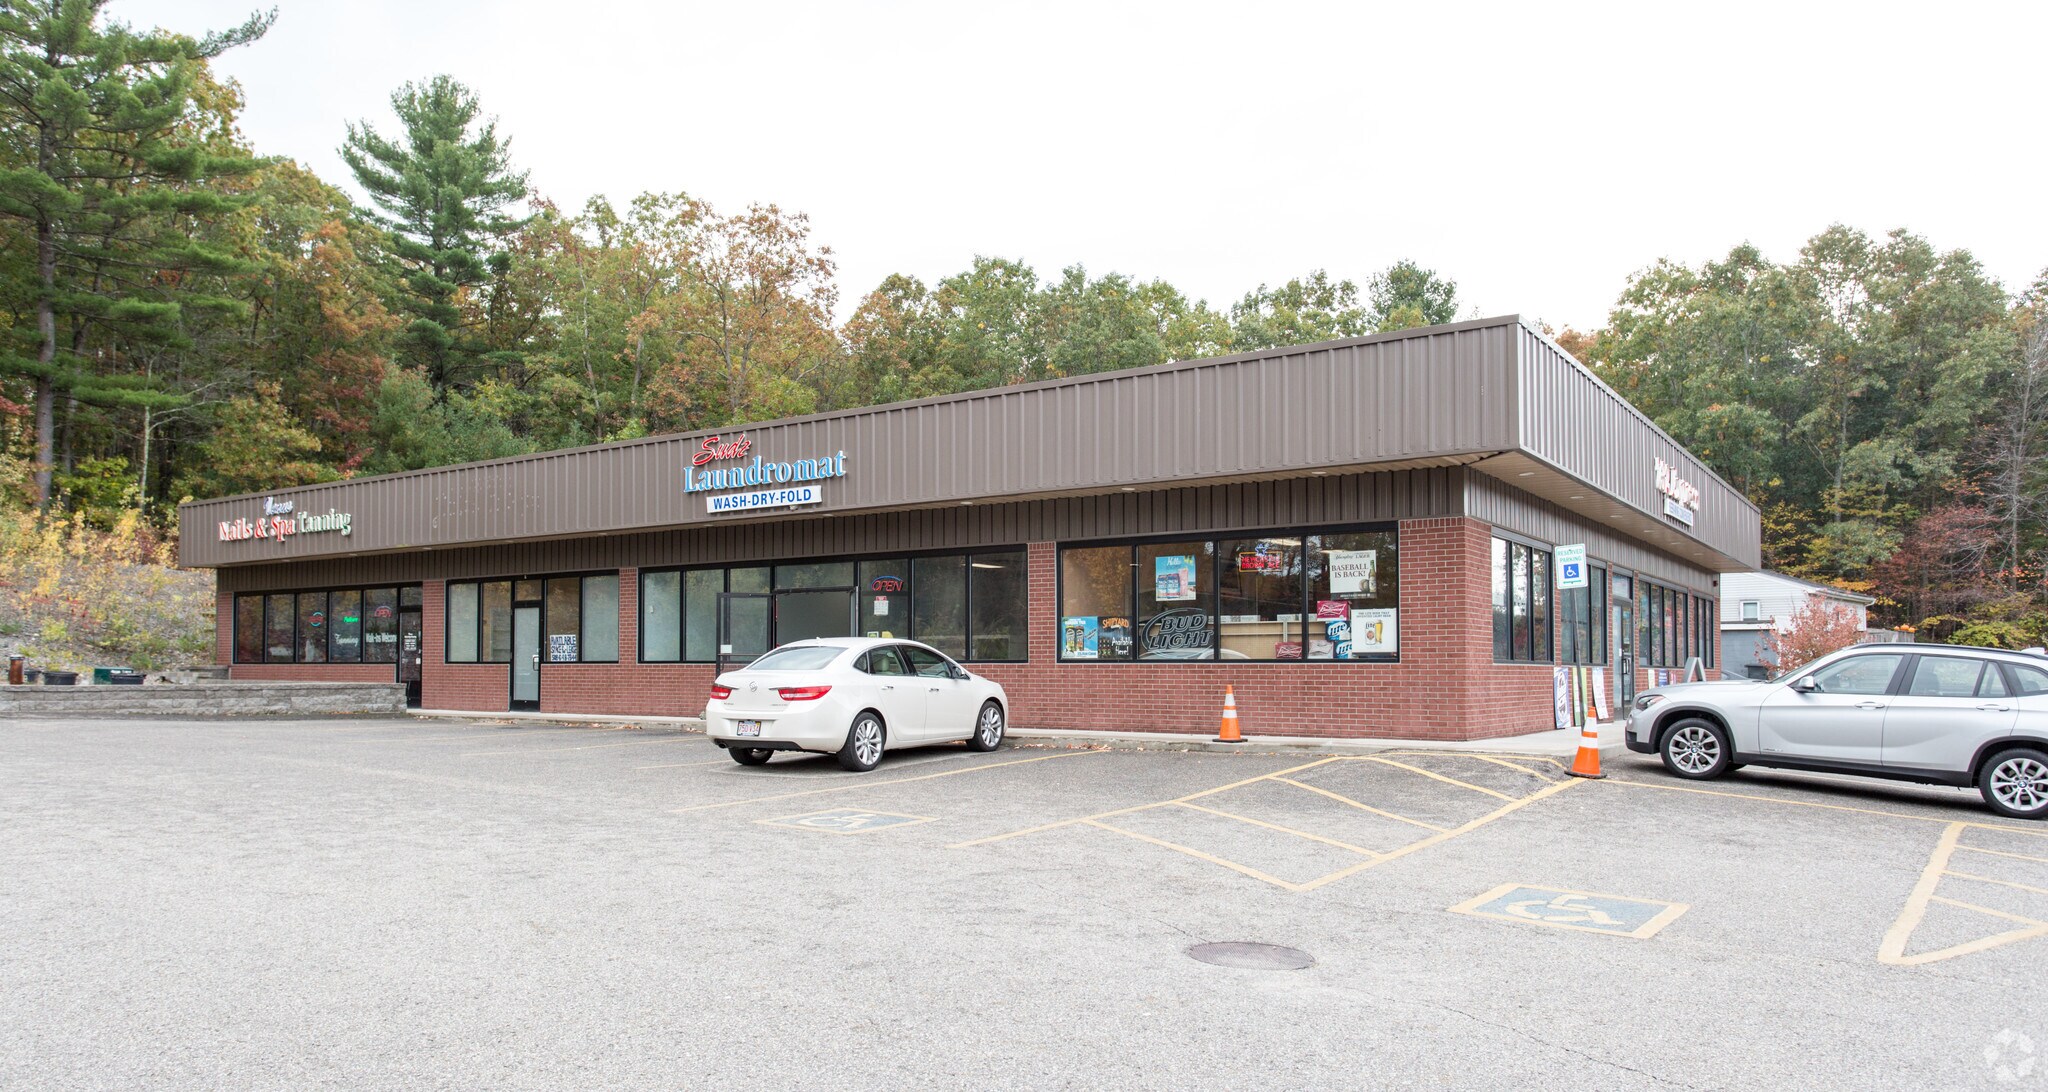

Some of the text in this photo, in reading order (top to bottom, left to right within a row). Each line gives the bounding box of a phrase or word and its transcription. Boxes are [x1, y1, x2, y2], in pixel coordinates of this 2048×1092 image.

[692, 434, 752, 466] Sudz
[684, 450, 846, 493] Laundromat
[713, 488, 812, 510] WASH-DRY-FOLD
[219, 508, 352, 542] Nails & Spa Tanning
[1331, 563, 1369, 572] BASEBALL
[871, 580, 903, 592] OPEN
[374, 607, 392, 617] OPEN
[1102, 617, 1130, 629] SHIPYARD
[1160, 614, 1206, 633] BUD
[334, 633, 359, 647] Tanning
[1111, 636, 1133, 647] Available
[1149, 629, 1214, 650] LIGHT
[1115, 645, 1129, 656] Here!
